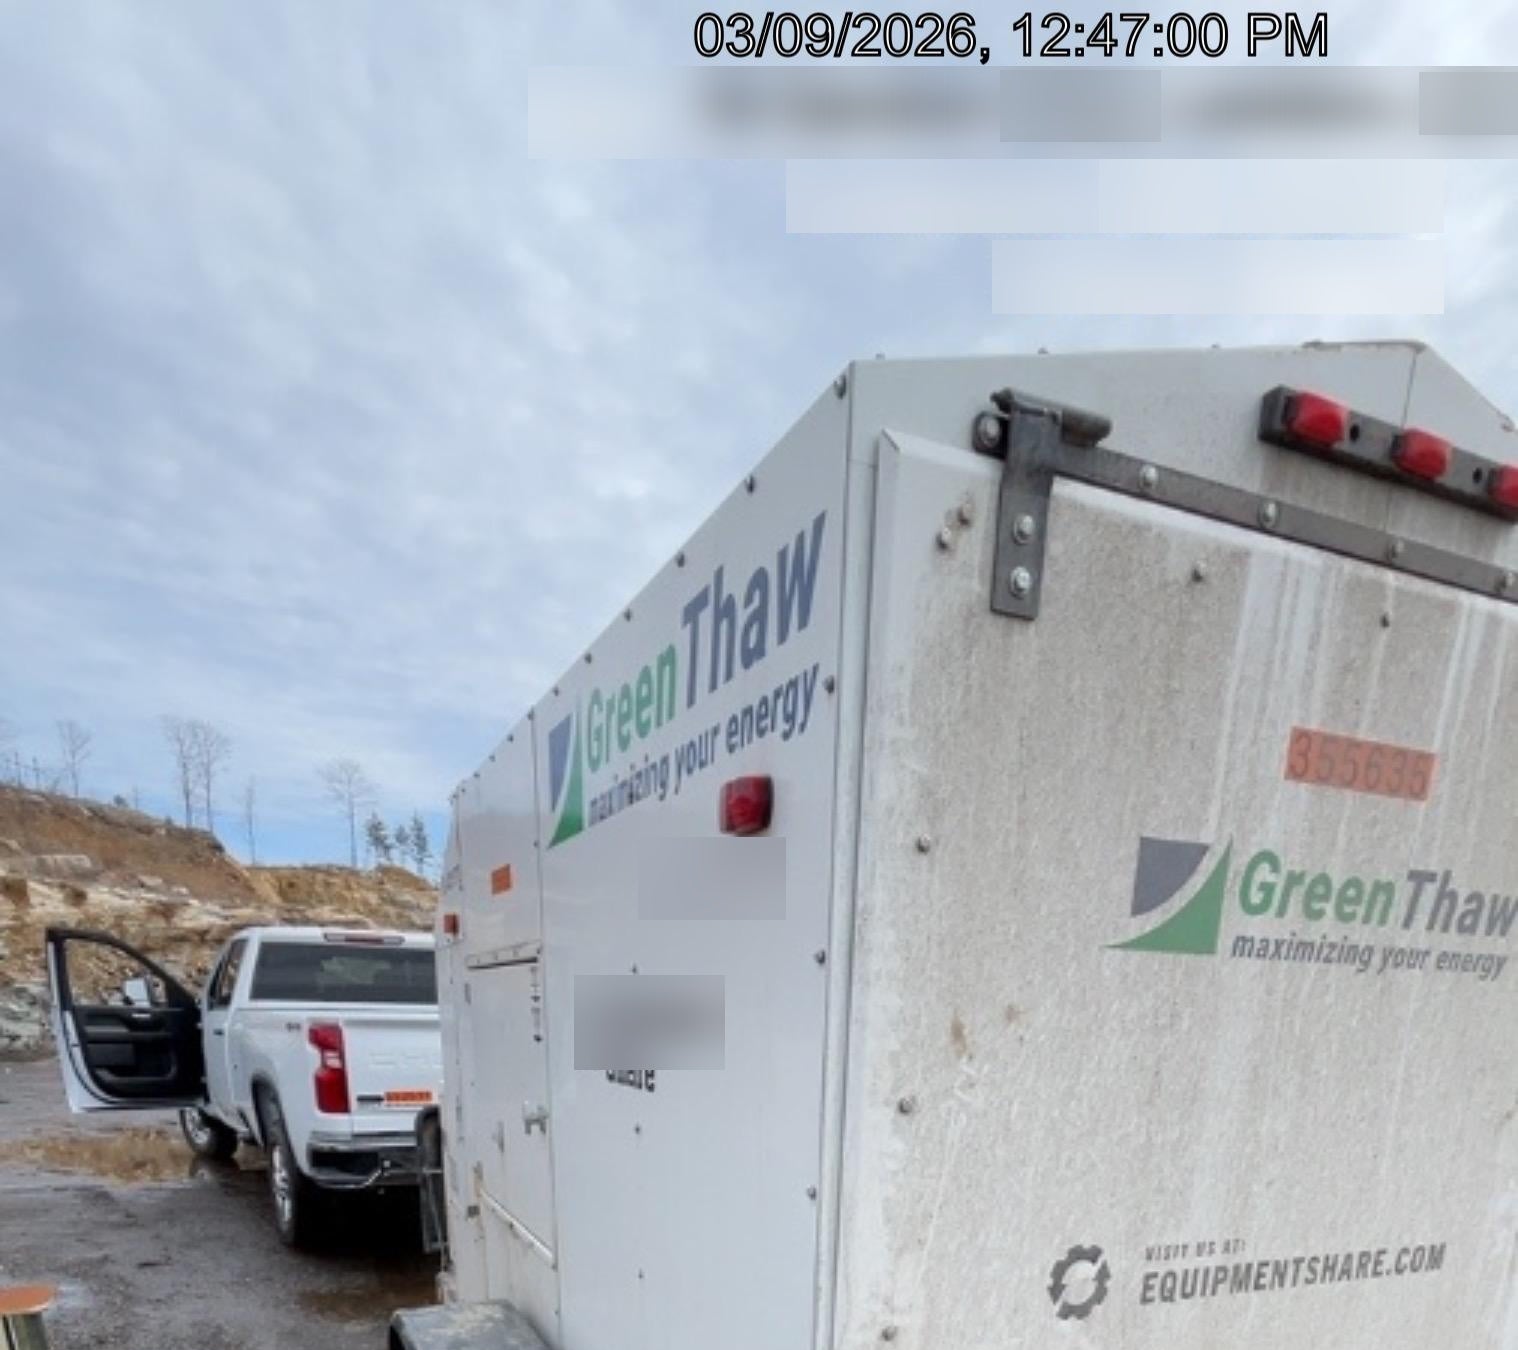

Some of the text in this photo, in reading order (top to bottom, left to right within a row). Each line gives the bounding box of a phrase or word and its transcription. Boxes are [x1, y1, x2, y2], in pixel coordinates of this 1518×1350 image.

[589, 662, 820, 826] maximizing your energy
[1230, 931, 1509, 981] maximizing your energy
[1139, 1242, 1448, 1306] EQUIPMENTSHARE.COM
[1145, 1244, 1189, 1261] VISIT
[1196, 1240, 1216, 1257] US
